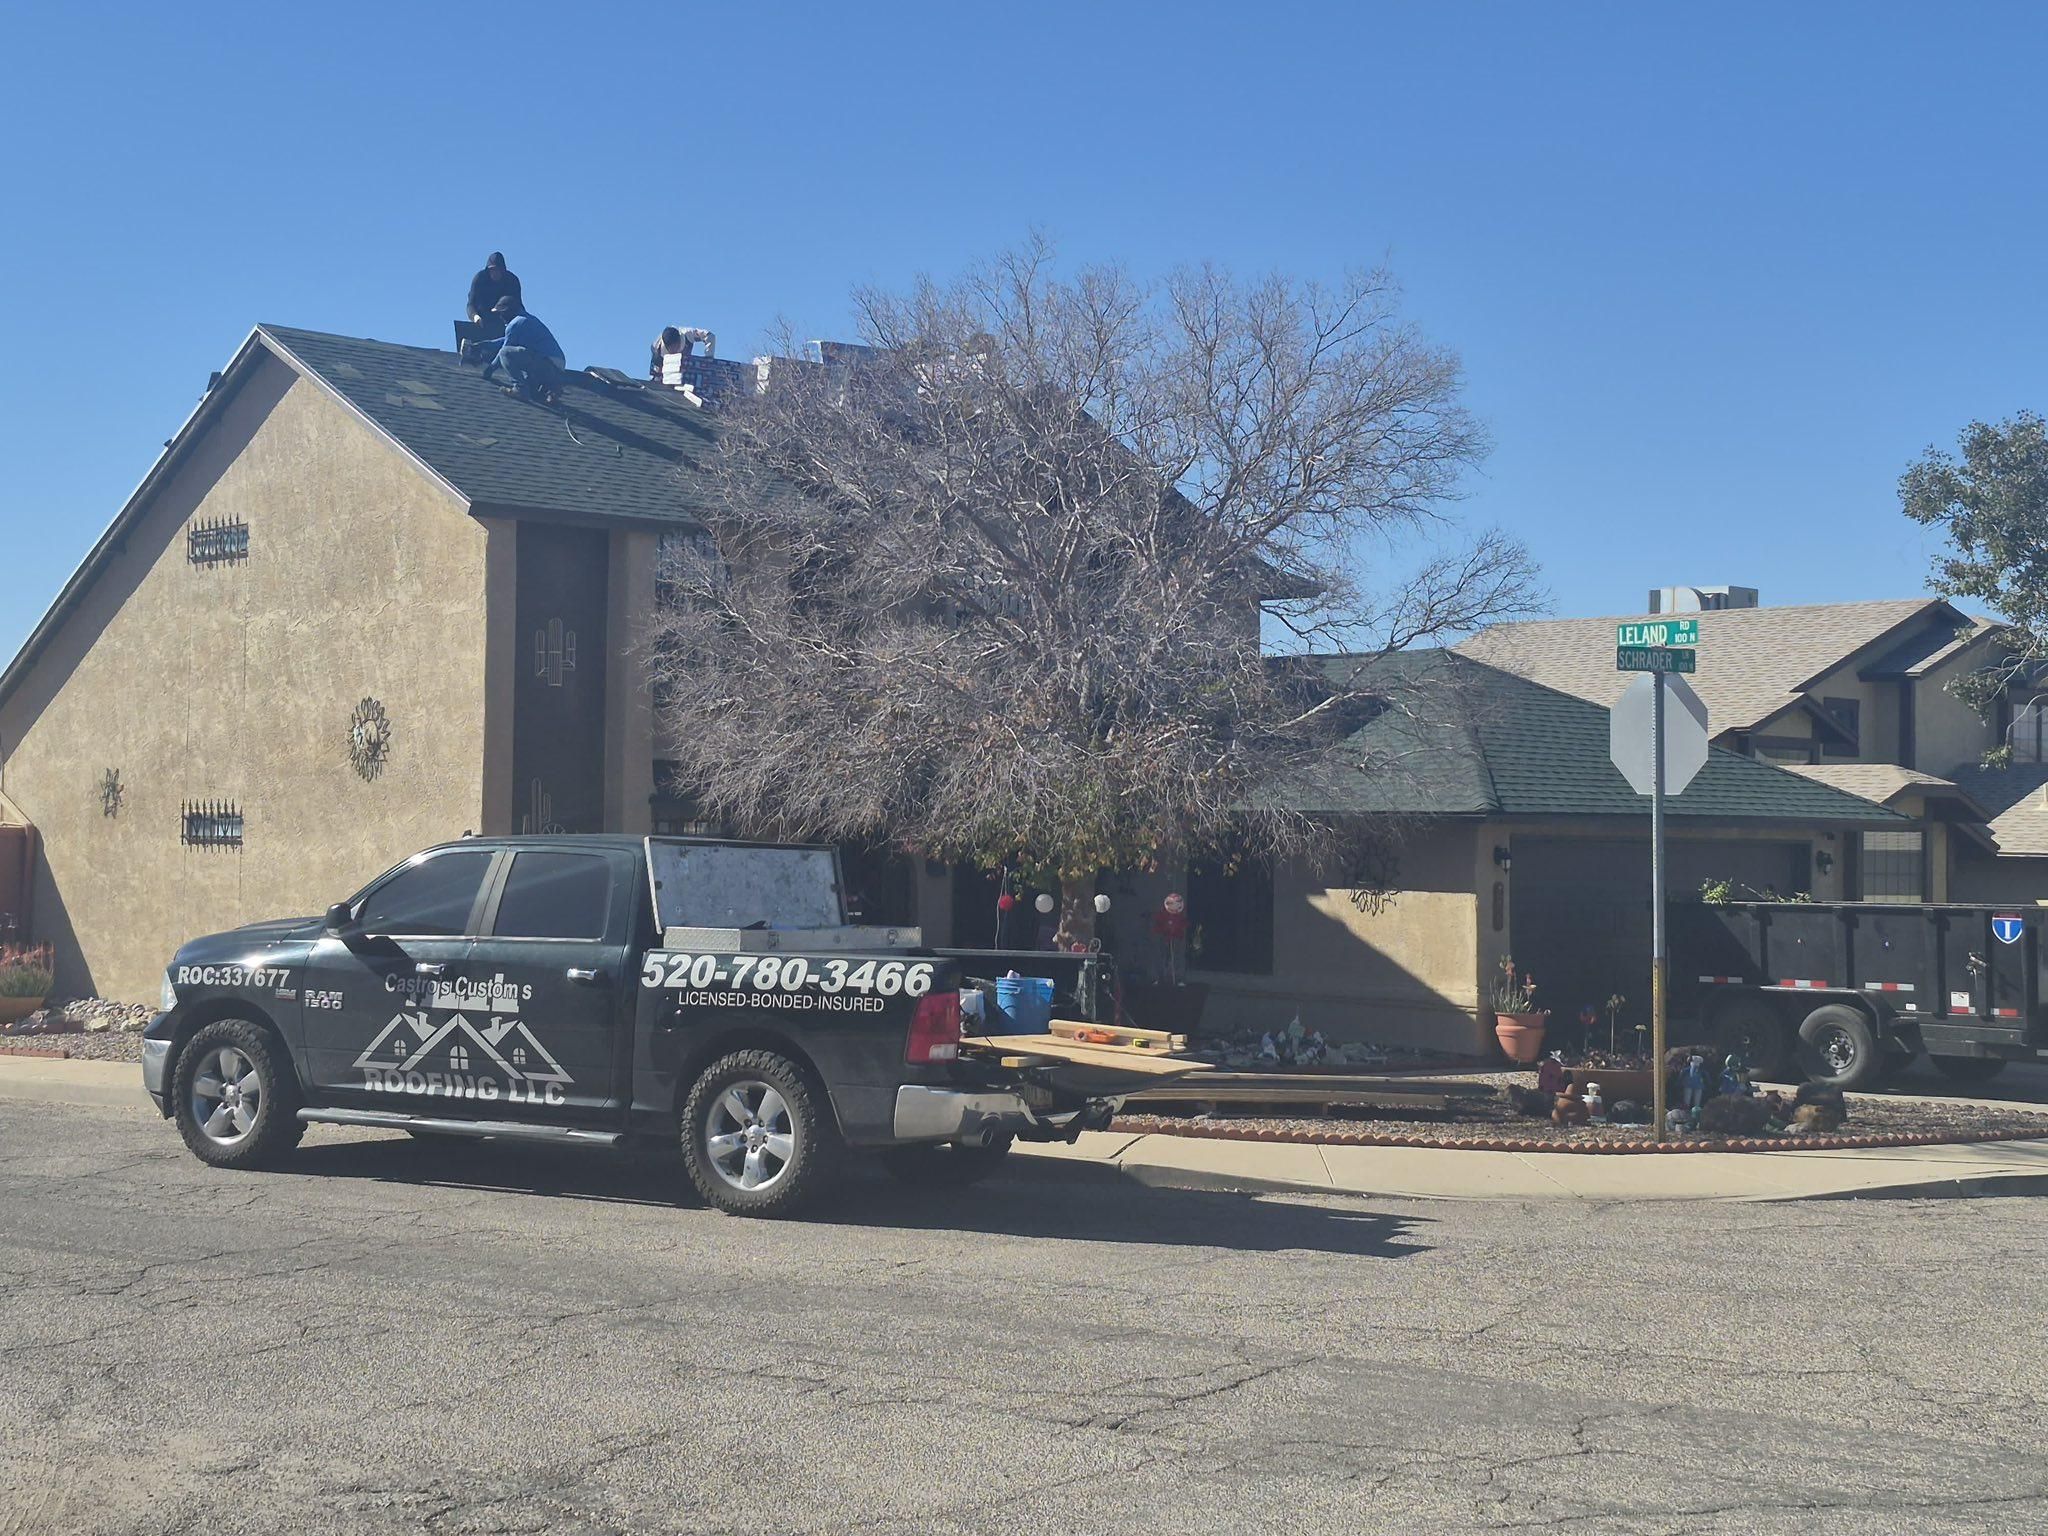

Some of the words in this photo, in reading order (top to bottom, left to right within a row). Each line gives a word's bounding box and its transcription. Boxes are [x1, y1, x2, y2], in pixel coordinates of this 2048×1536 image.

[1618, 625, 1667, 645] LELAND
[1680, 621, 1690, 631] RD
[1675, 633, 1688, 643] 100
[1690, 632, 1696, 642] N
[1618, 651, 1672, 669] SCHRADER
[177, 966, 291, 988] ROC:337677
[641, 954, 934, 997] 520-780-3466
[304, 989, 344, 1001] RAM
[304, 999, 343, 1010] 1500
[678, 991, 885, 1013] LICENSED-BONDED-INSURED
[363, 1067, 499, 1100] ROOFING
[507, 1077, 566, 1106] LLC
